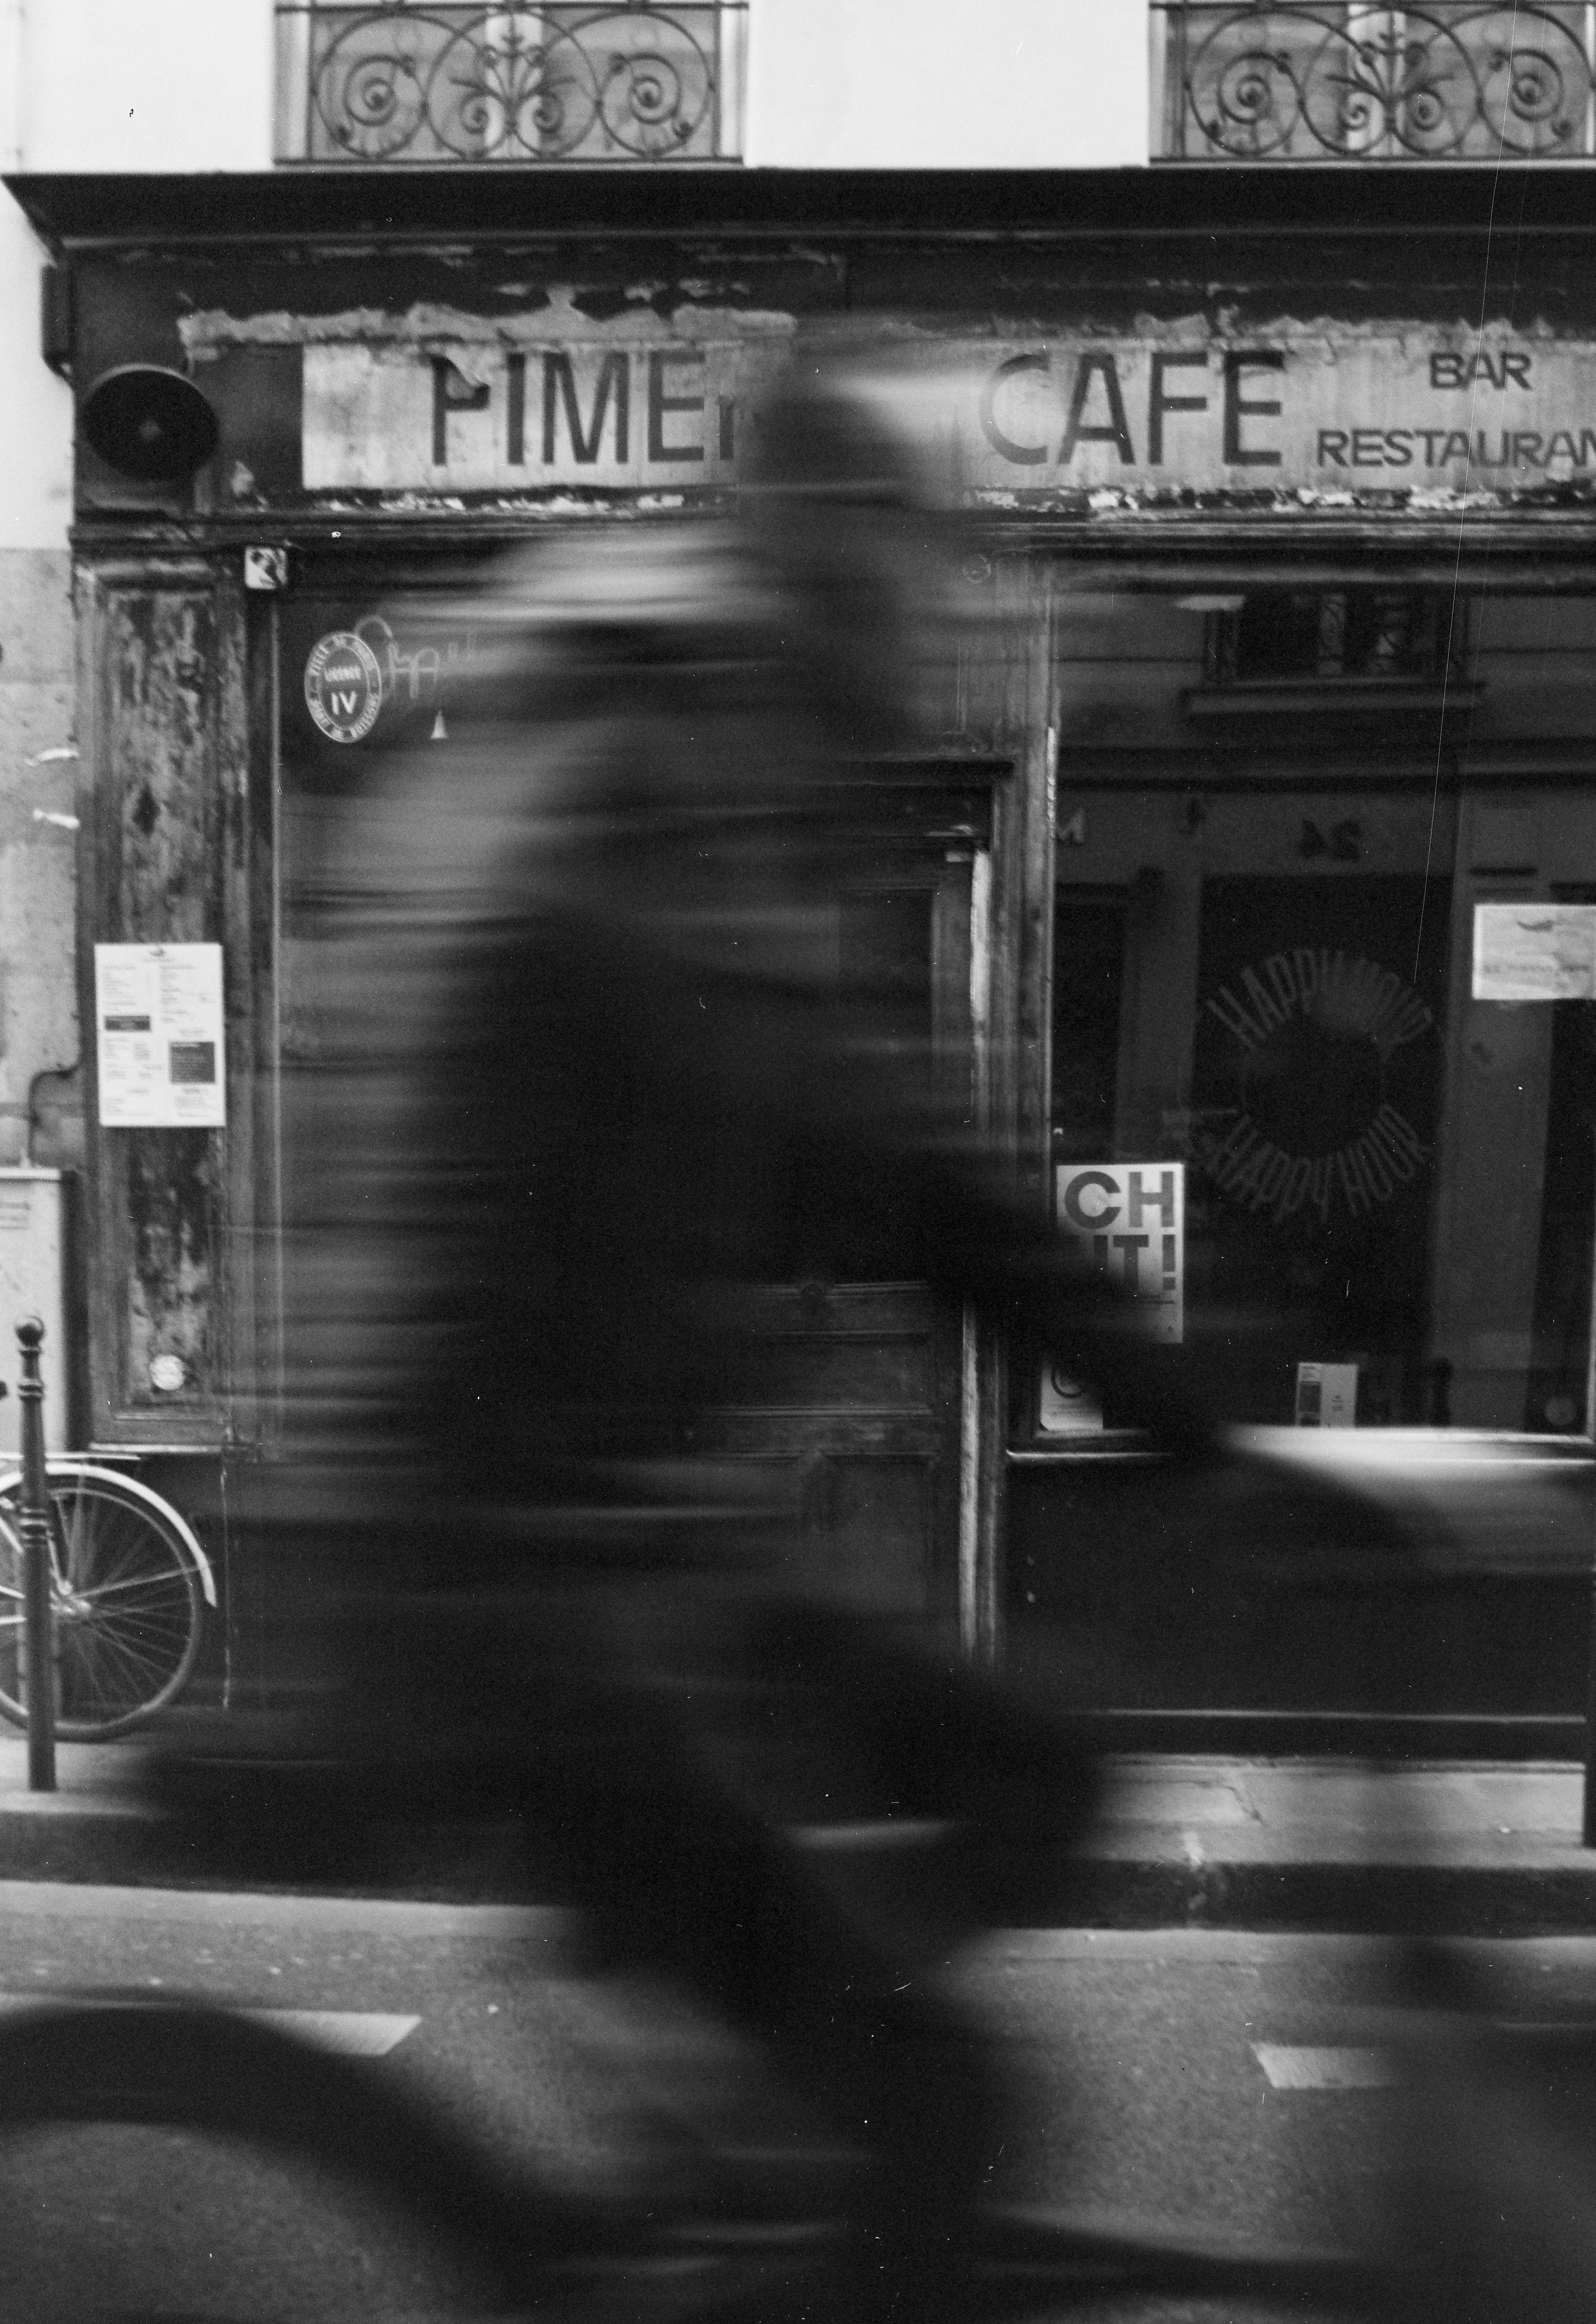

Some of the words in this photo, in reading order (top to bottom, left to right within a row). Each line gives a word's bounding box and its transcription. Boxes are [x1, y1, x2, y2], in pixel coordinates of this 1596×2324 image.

[1430, 352, 1532, 391] BAR
[432, 350, 734, 466] PIME
[979, 350, 1286, 467] CAFE
[331, 690, 357, 715] IV
[1211, 1115, 1333, 1222] HAPPY
[1065, 1170, 1175, 1229] CH
